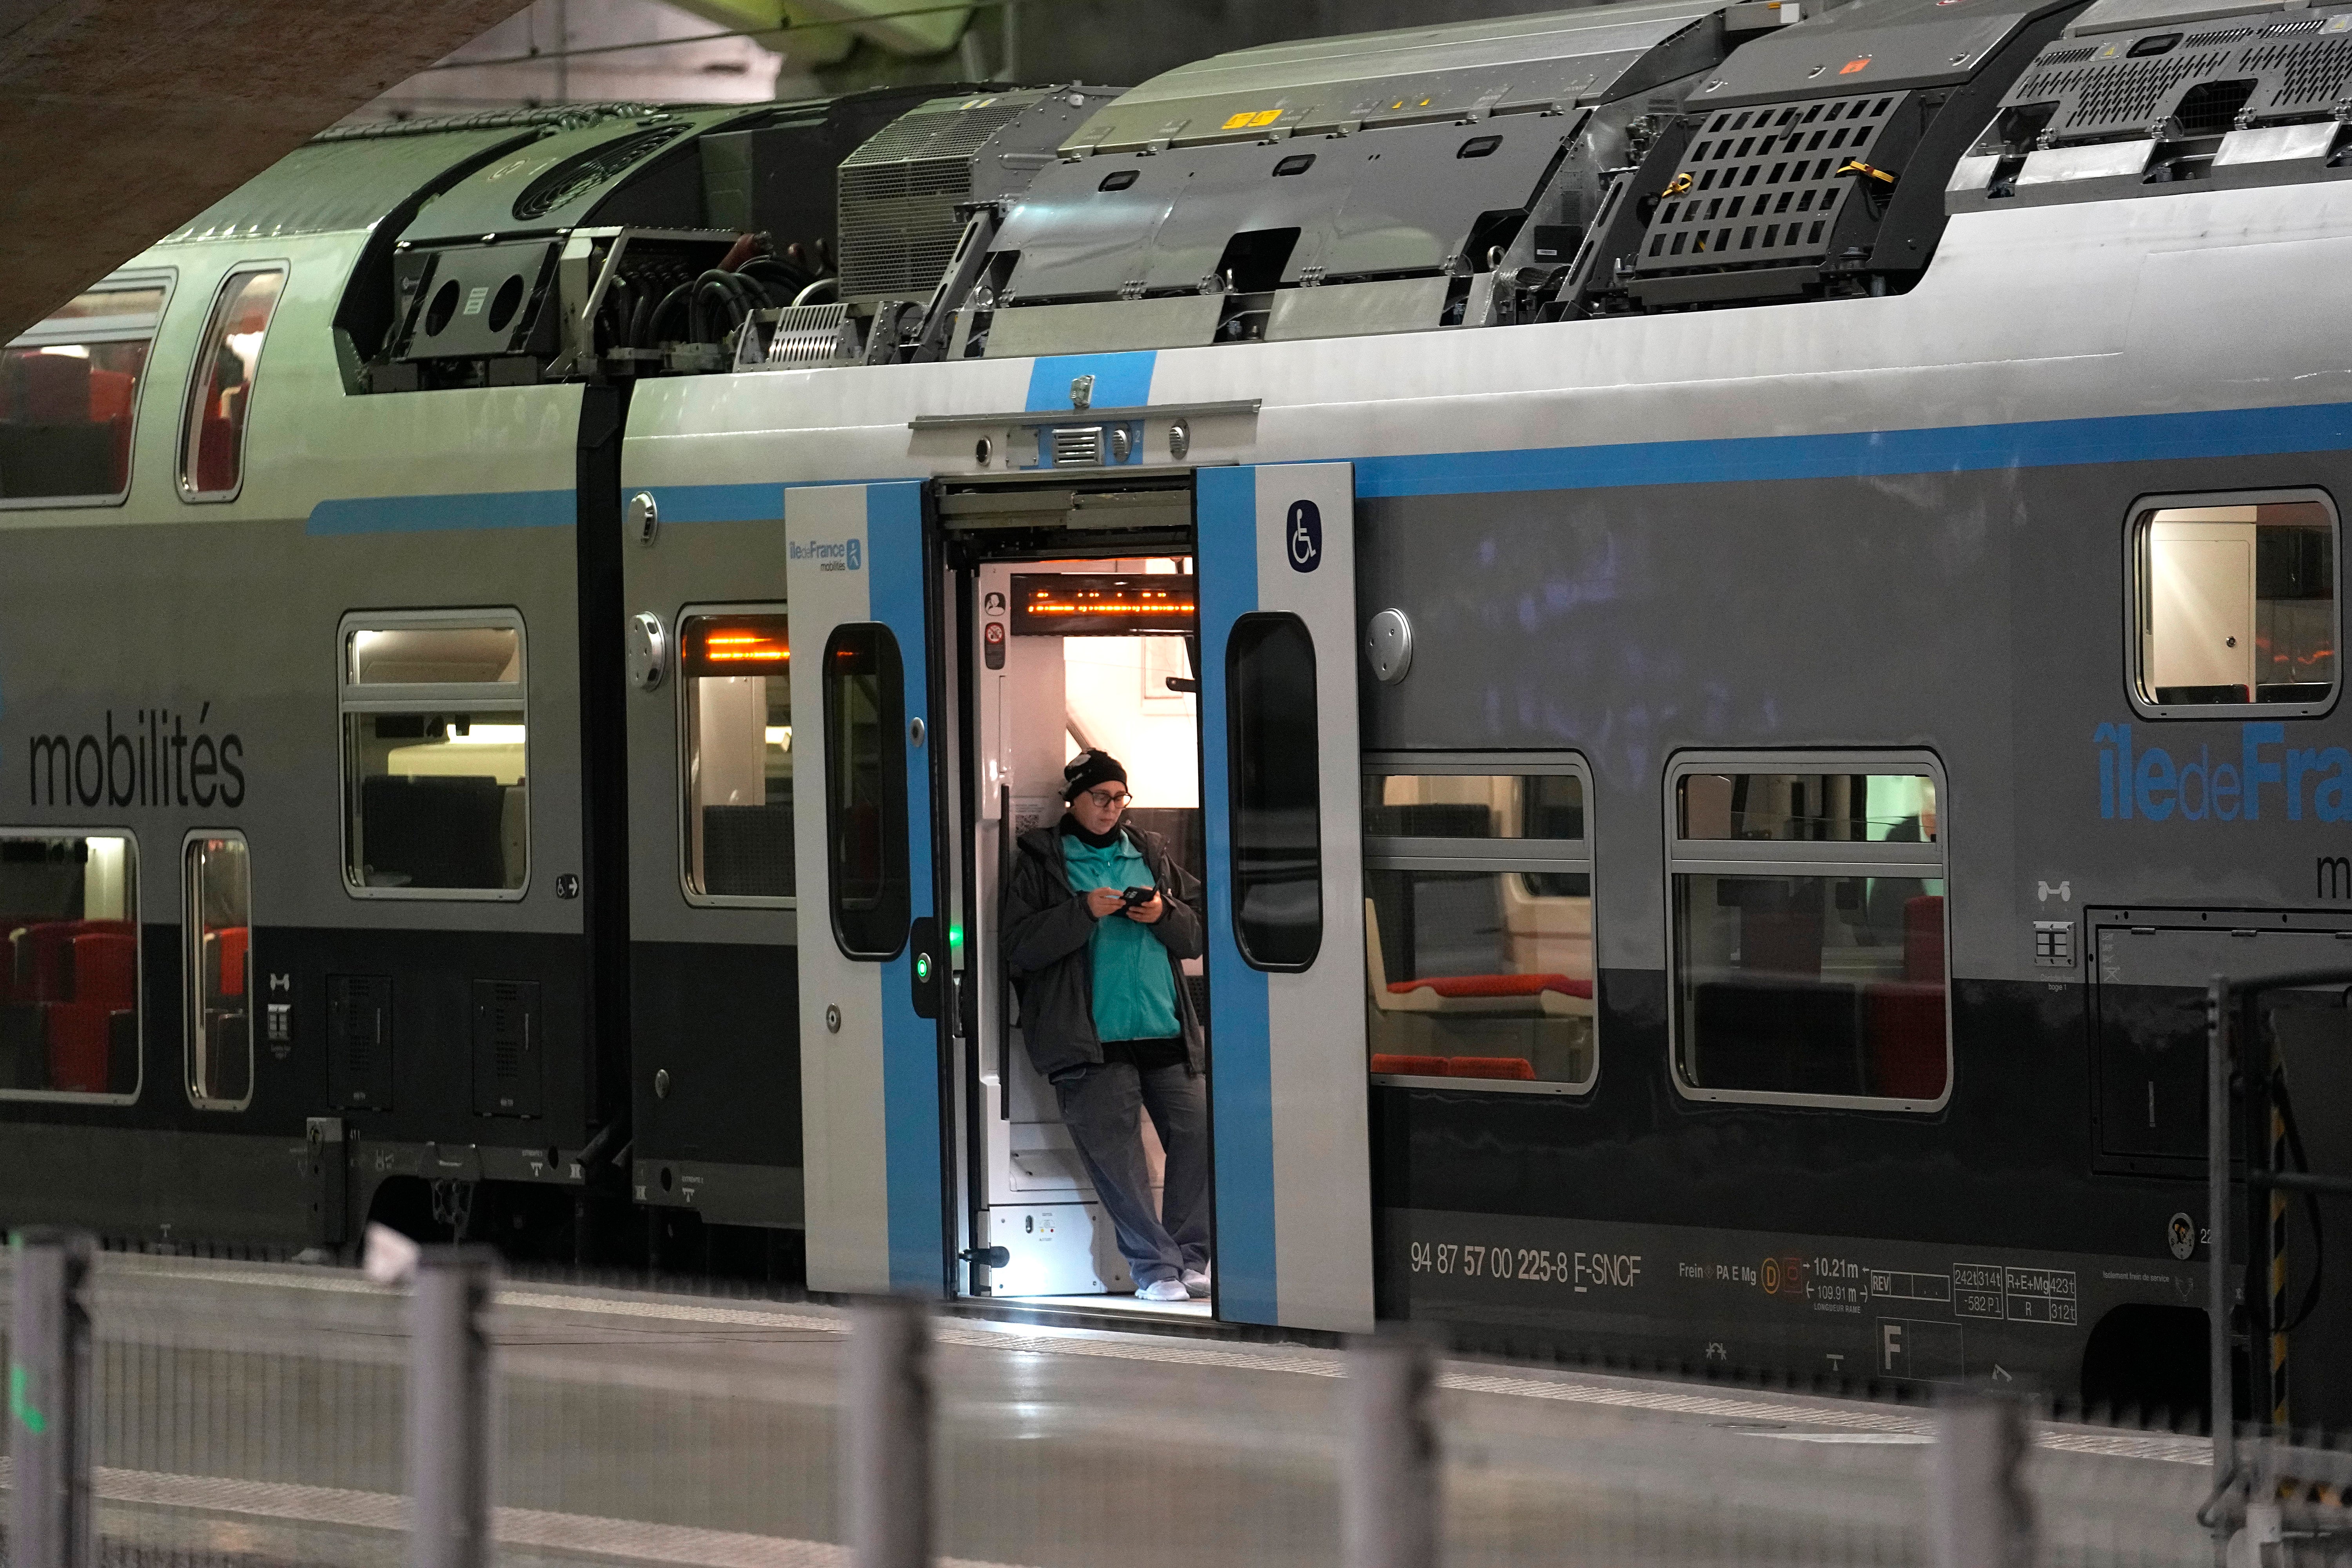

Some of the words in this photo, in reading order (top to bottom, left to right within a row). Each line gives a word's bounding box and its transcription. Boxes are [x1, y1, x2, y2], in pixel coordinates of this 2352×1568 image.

[1134, 430, 1140, 443] 2
[29, 701, 246, 808] mobilités
[2048, 982, 2063, 992] bogie
[1411, 1242, 1432, 1272] 94
[1437, 1243, 1458, 1274] 87
[1464, 1245, 1485, 1276] 57
[1491, 1247, 1512, 1279] 00
[1518, 1249, 1568, 1283] 225-8
[1574, 1252, 1642, 1292] F-SNCF
[1679, 1262, 1703, 1278] Frein
[1717, 1265, 1730, 1281] PA
[1732, 1266, 1739, 1281] E
[1742, 1267, 1757, 1286] Mg
[1766, 1266, 1776, 1287] D
[1873, 1275, 1889, 1291] REV
[1955, 1270, 1977, 1285] 242t
[1978, 1271, 2001, 1287] 314t
[2007, 1274, 2050, 1295] R+E+Mg
[2050, 1278, 2075, 1294] 423t
[1845, 1305, 1861, 1314] RAME
[2025, 1301, 2032, 1316] R
[2051, 1303, 2076, 1320] 312t
[1884, 1325, 1902, 1370] F
